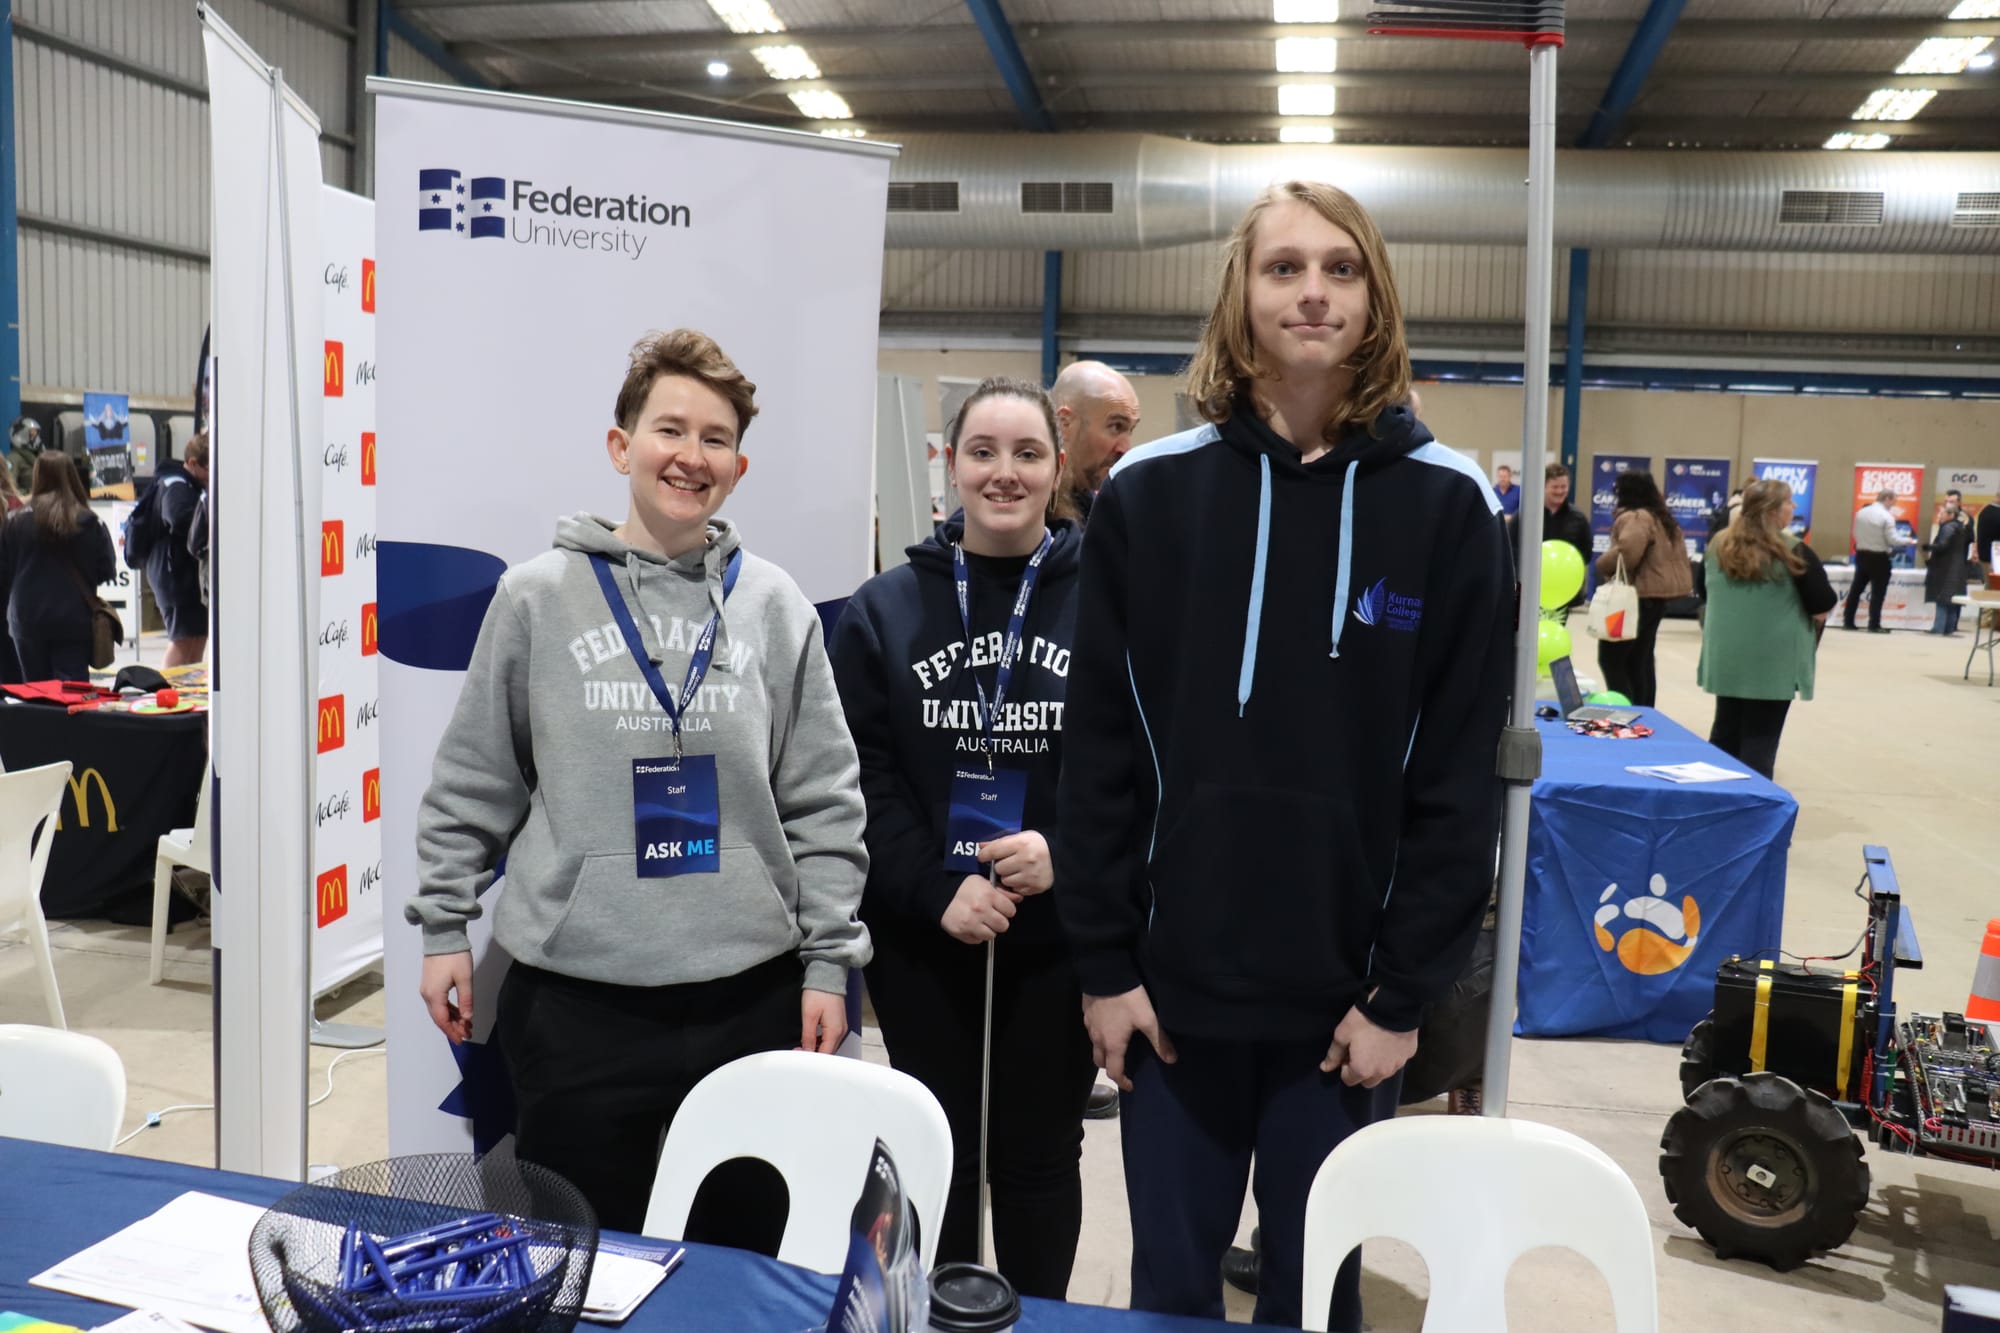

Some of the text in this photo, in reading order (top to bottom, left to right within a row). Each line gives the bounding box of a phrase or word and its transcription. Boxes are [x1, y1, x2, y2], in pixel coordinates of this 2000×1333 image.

[513, 180, 691, 228] Federation
[512, 216, 647, 260] University
[324, 262, 348, 294] Café
[324, 443, 348, 472] Café
[1761, 466, 1808, 480] APPLY
[1862, 470, 1914, 481] SCHOOL
[1861, 479, 1916, 495] BASED
[1665, 497, 1706, 508] CAREER
[1388, 591, 1423, 608] Kurna
[319, 619, 348, 648] cCafé
[357, 698, 380, 729] McC
[955, 736, 1049, 753] AUSTRALIA
[667, 785, 686, 795] Staff
[980, 792, 998, 801] Staff
[644, 839, 715, 860] ASK ME
[360, 859, 382, 895] McC
